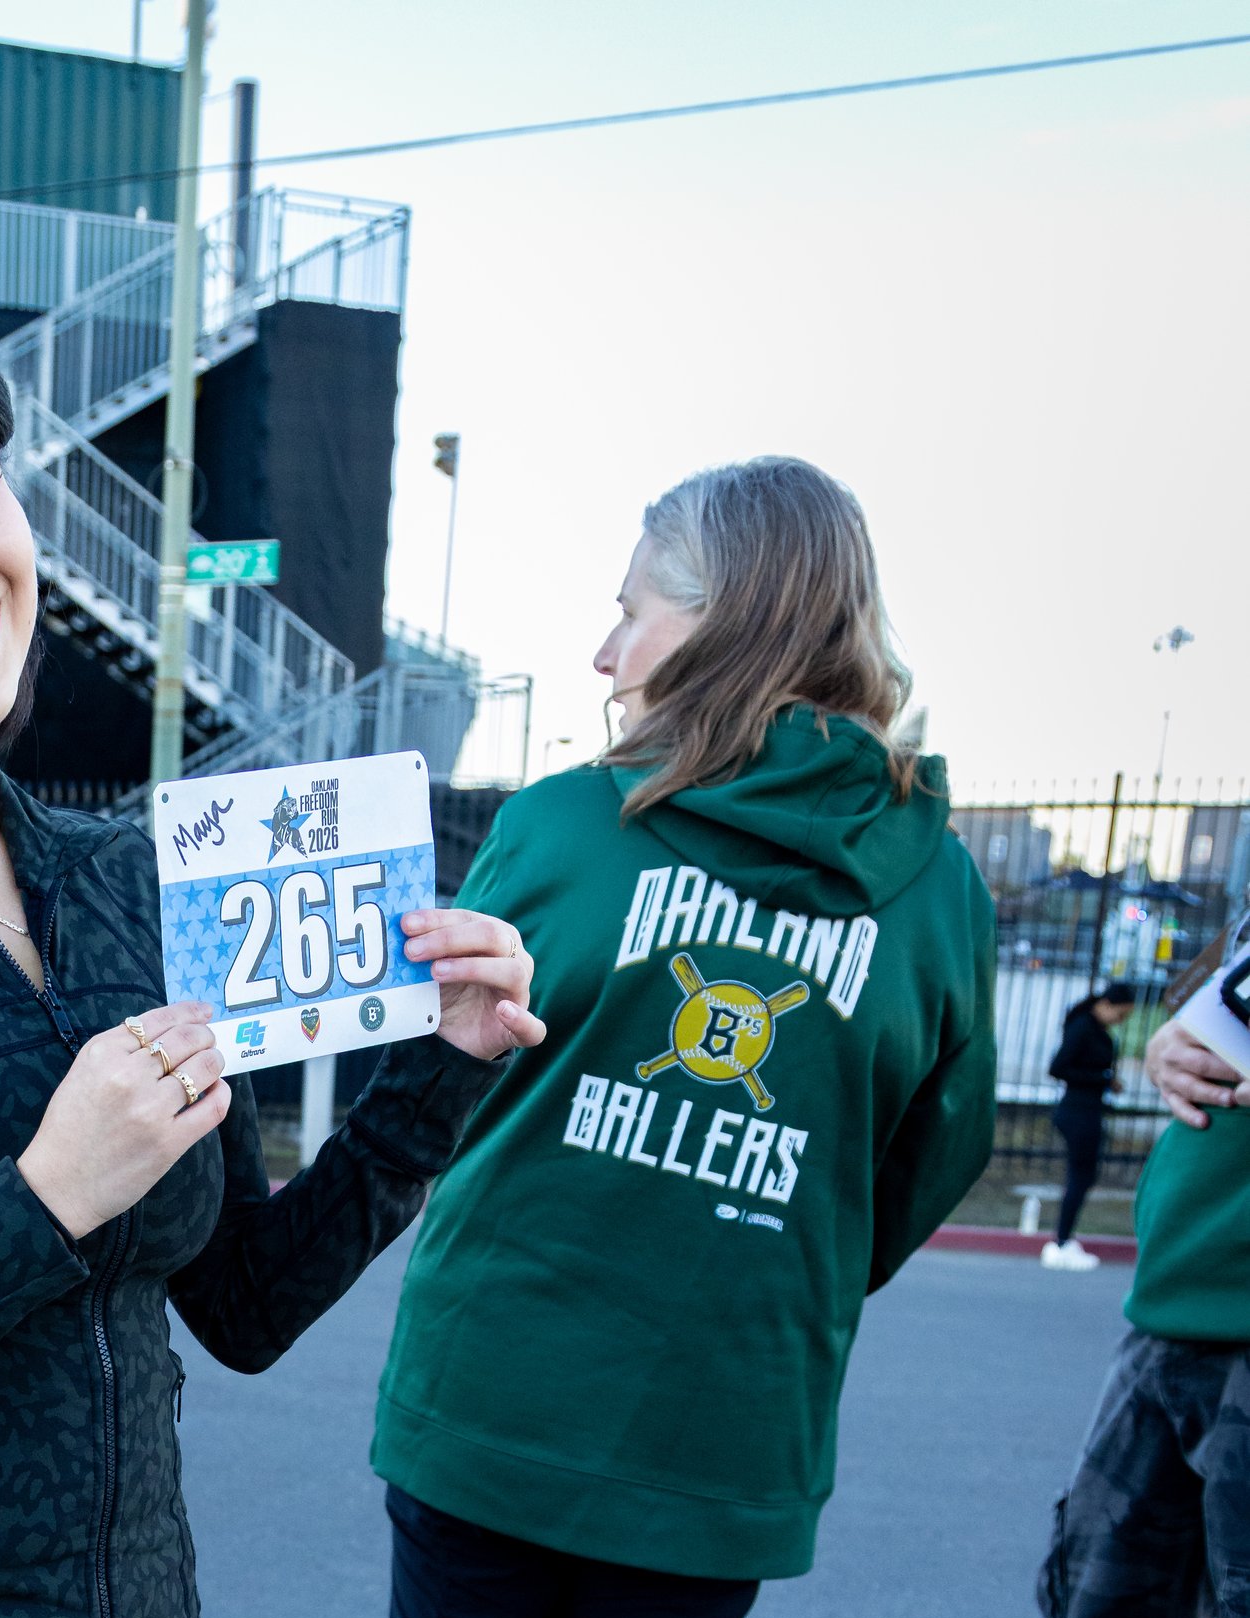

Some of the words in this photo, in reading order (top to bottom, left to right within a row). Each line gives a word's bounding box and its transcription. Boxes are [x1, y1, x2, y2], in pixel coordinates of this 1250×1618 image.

[311, 778, 339, 793] OAKLAND
[300, 791, 338, 812] FREEDOM
[321, 807, 338, 827] RUN
[173, 797, 234, 867] Maya
[308, 825, 339, 854] 2026
[220, 861, 388, 1012] 265
[614, 865, 878, 1021] OAKLAND
[240, 1047, 267, 1059] Caltrans
[563, 1073, 809, 1205] BALLERS
